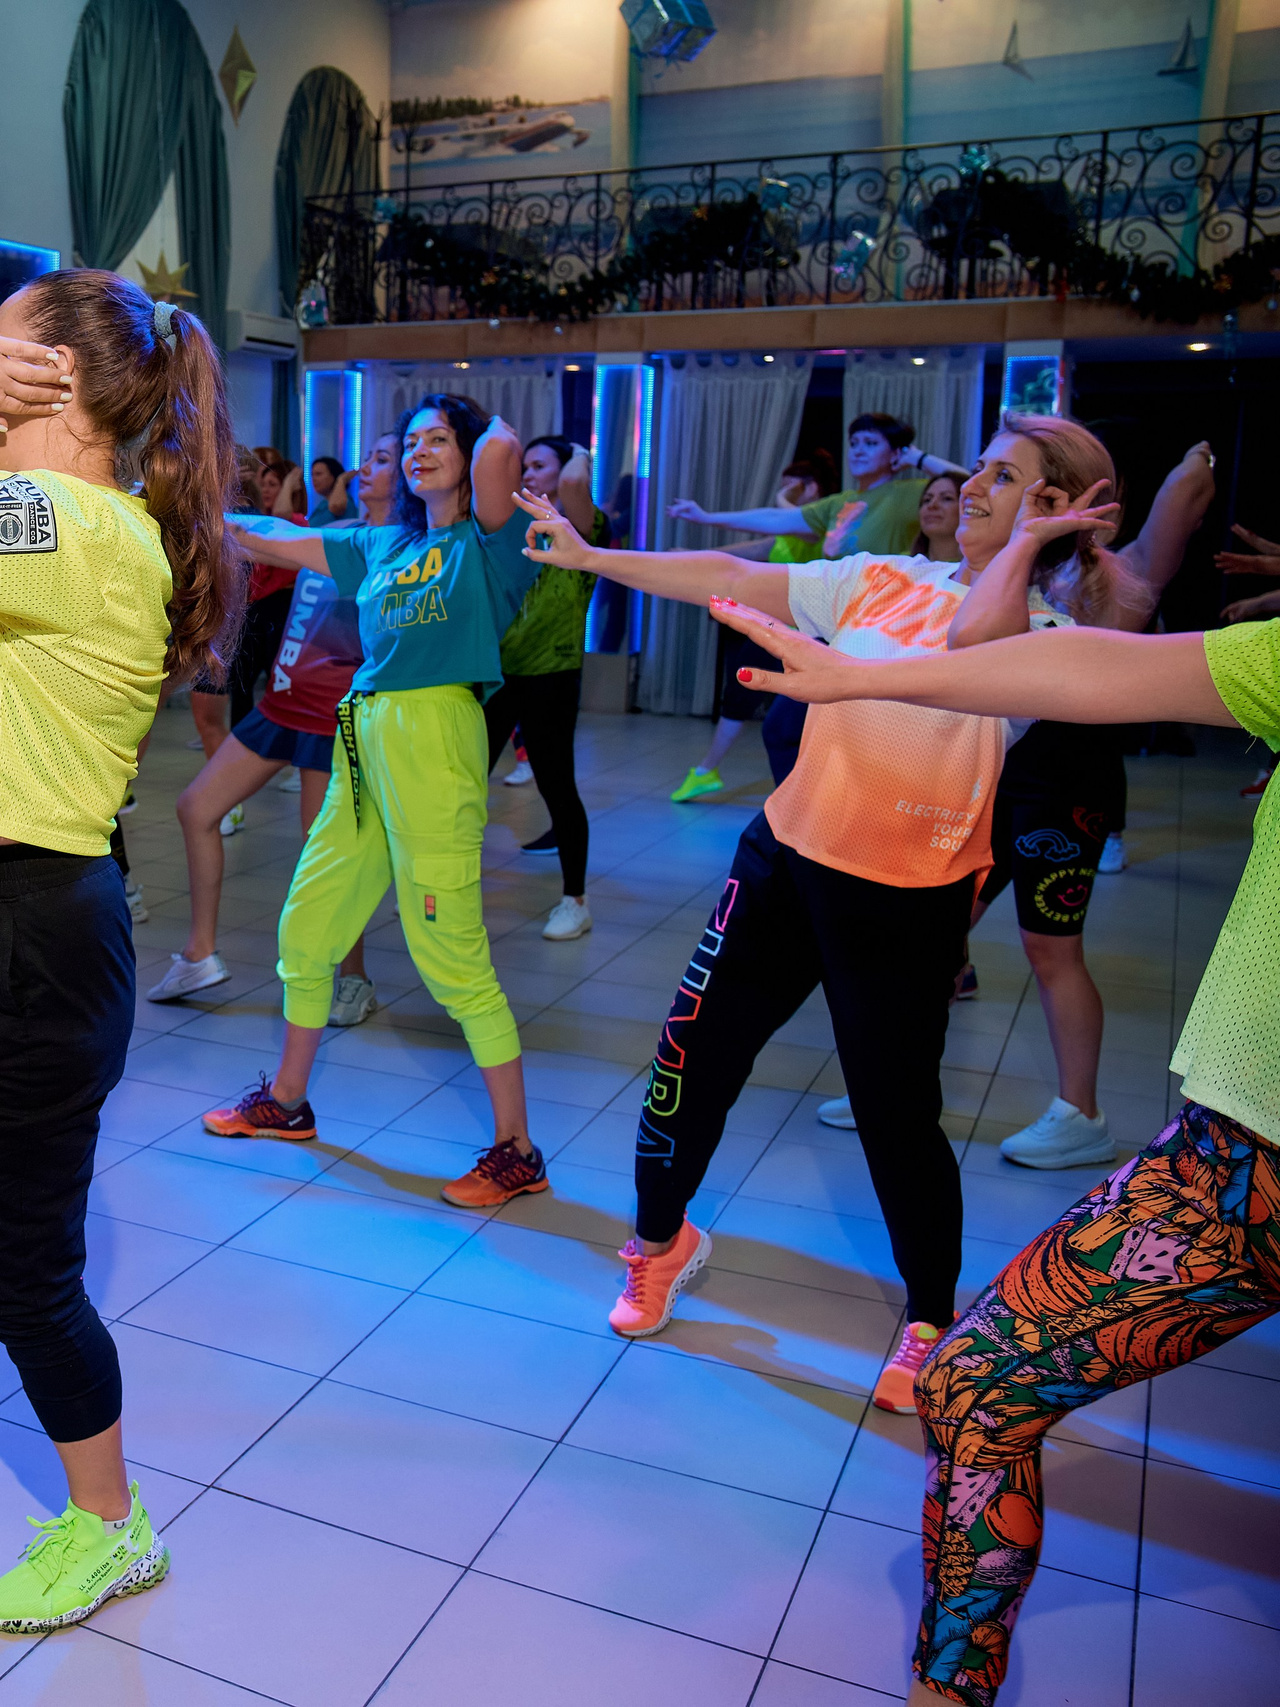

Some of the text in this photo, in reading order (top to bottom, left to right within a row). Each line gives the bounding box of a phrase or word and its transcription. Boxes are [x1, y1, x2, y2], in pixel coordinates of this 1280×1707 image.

[15, 480, 51, 544] ZUMBA
[273, 574, 324, 693] UMBA
[895, 800, 976, 824] ELECTRIFY
[1036, 868, 1076, 892] HAPPY
